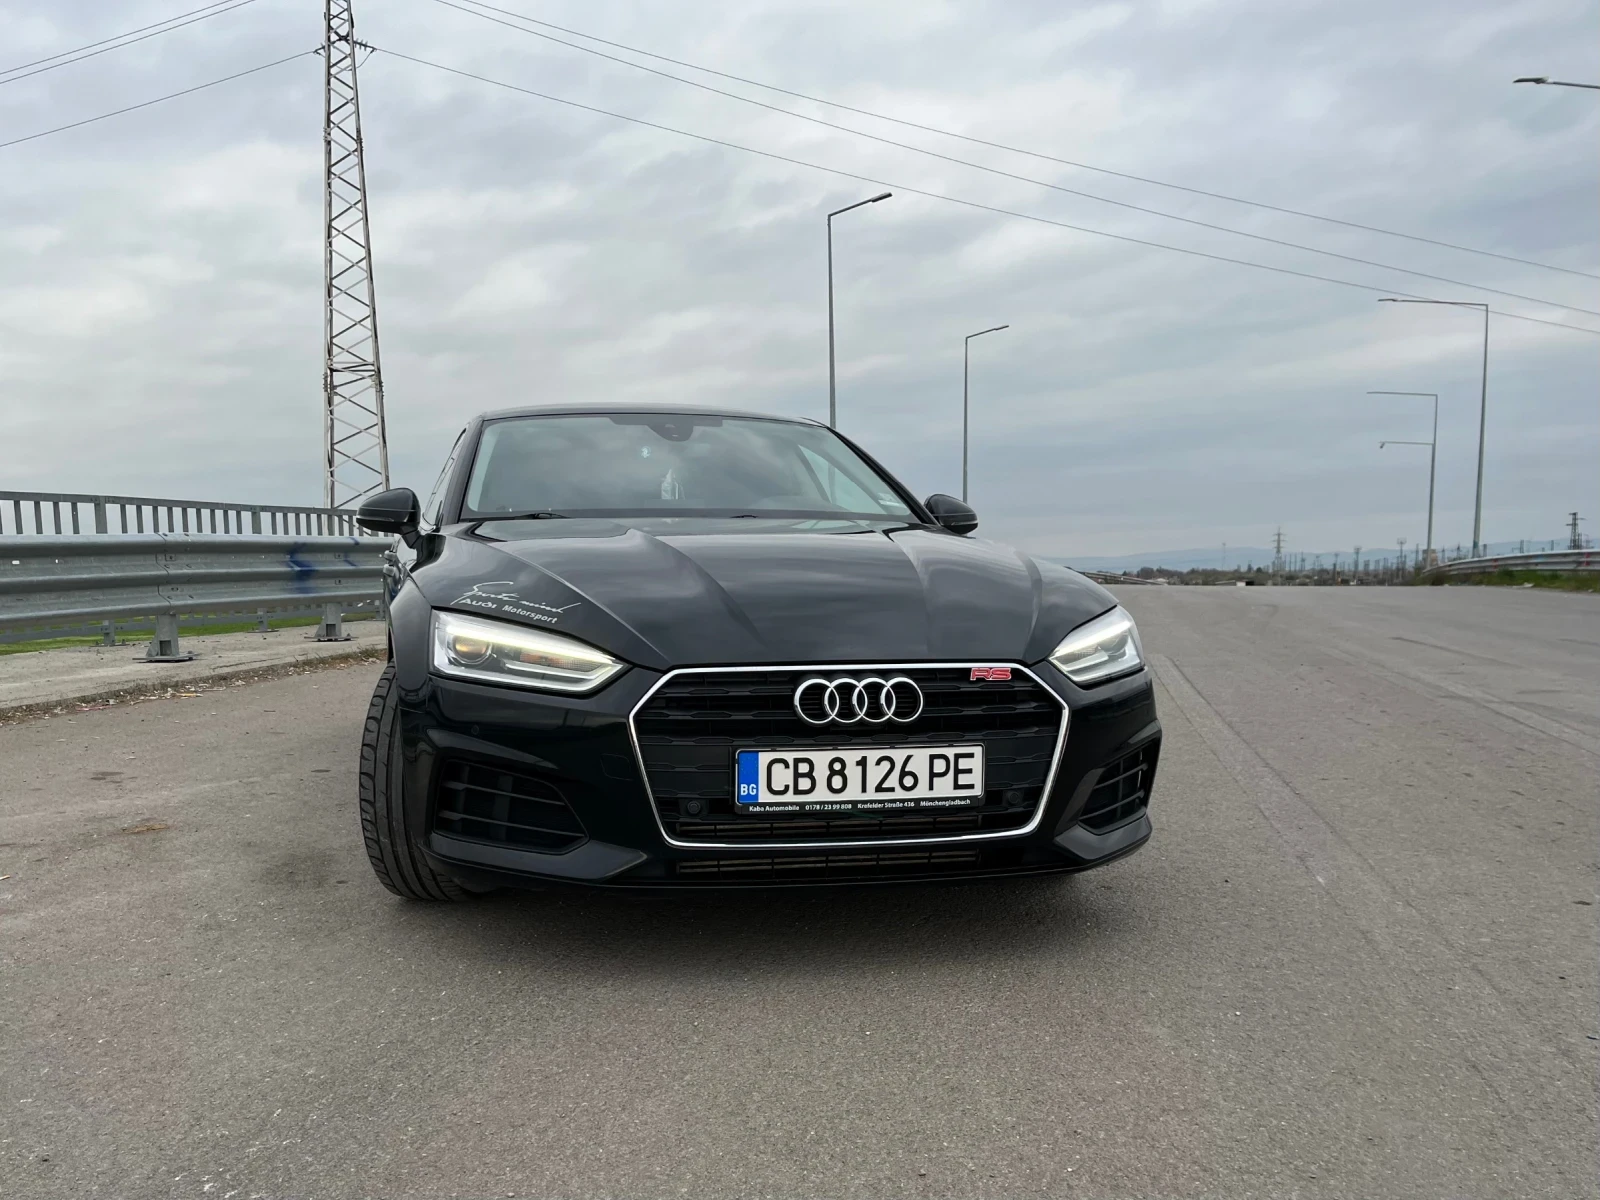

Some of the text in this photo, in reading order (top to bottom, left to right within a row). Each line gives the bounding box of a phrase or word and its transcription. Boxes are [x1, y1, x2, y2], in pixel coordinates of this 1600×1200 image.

[502, 604, 558, 624] Motorsport
[970, 667, 1012, 681] RS
[766, 752, 976, 796] CB 8126 PE
[740, 783, 757, 796] BG
[765, 804, 800, 812] Automobile
